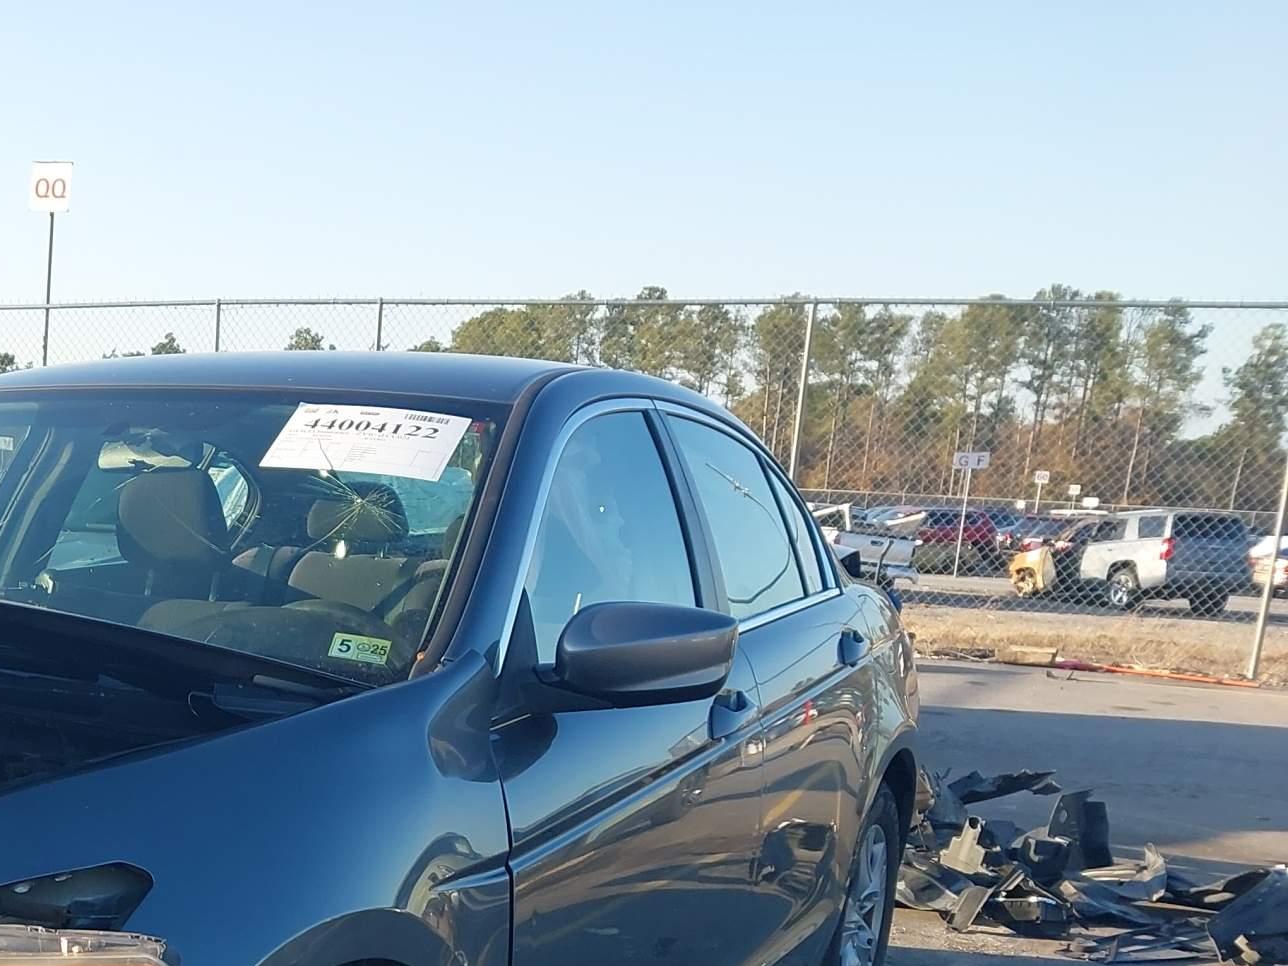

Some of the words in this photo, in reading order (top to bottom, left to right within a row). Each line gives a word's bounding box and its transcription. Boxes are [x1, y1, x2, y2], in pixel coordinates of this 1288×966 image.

[35, 177, 67, 199] QQ
[303, 417, 440, 440] 44004122
[958, 455, 969, 466] G
[977, 455, 985, 466] F
[338, 639, 352, 653] 5
[371, 644, 388, 656] 25
